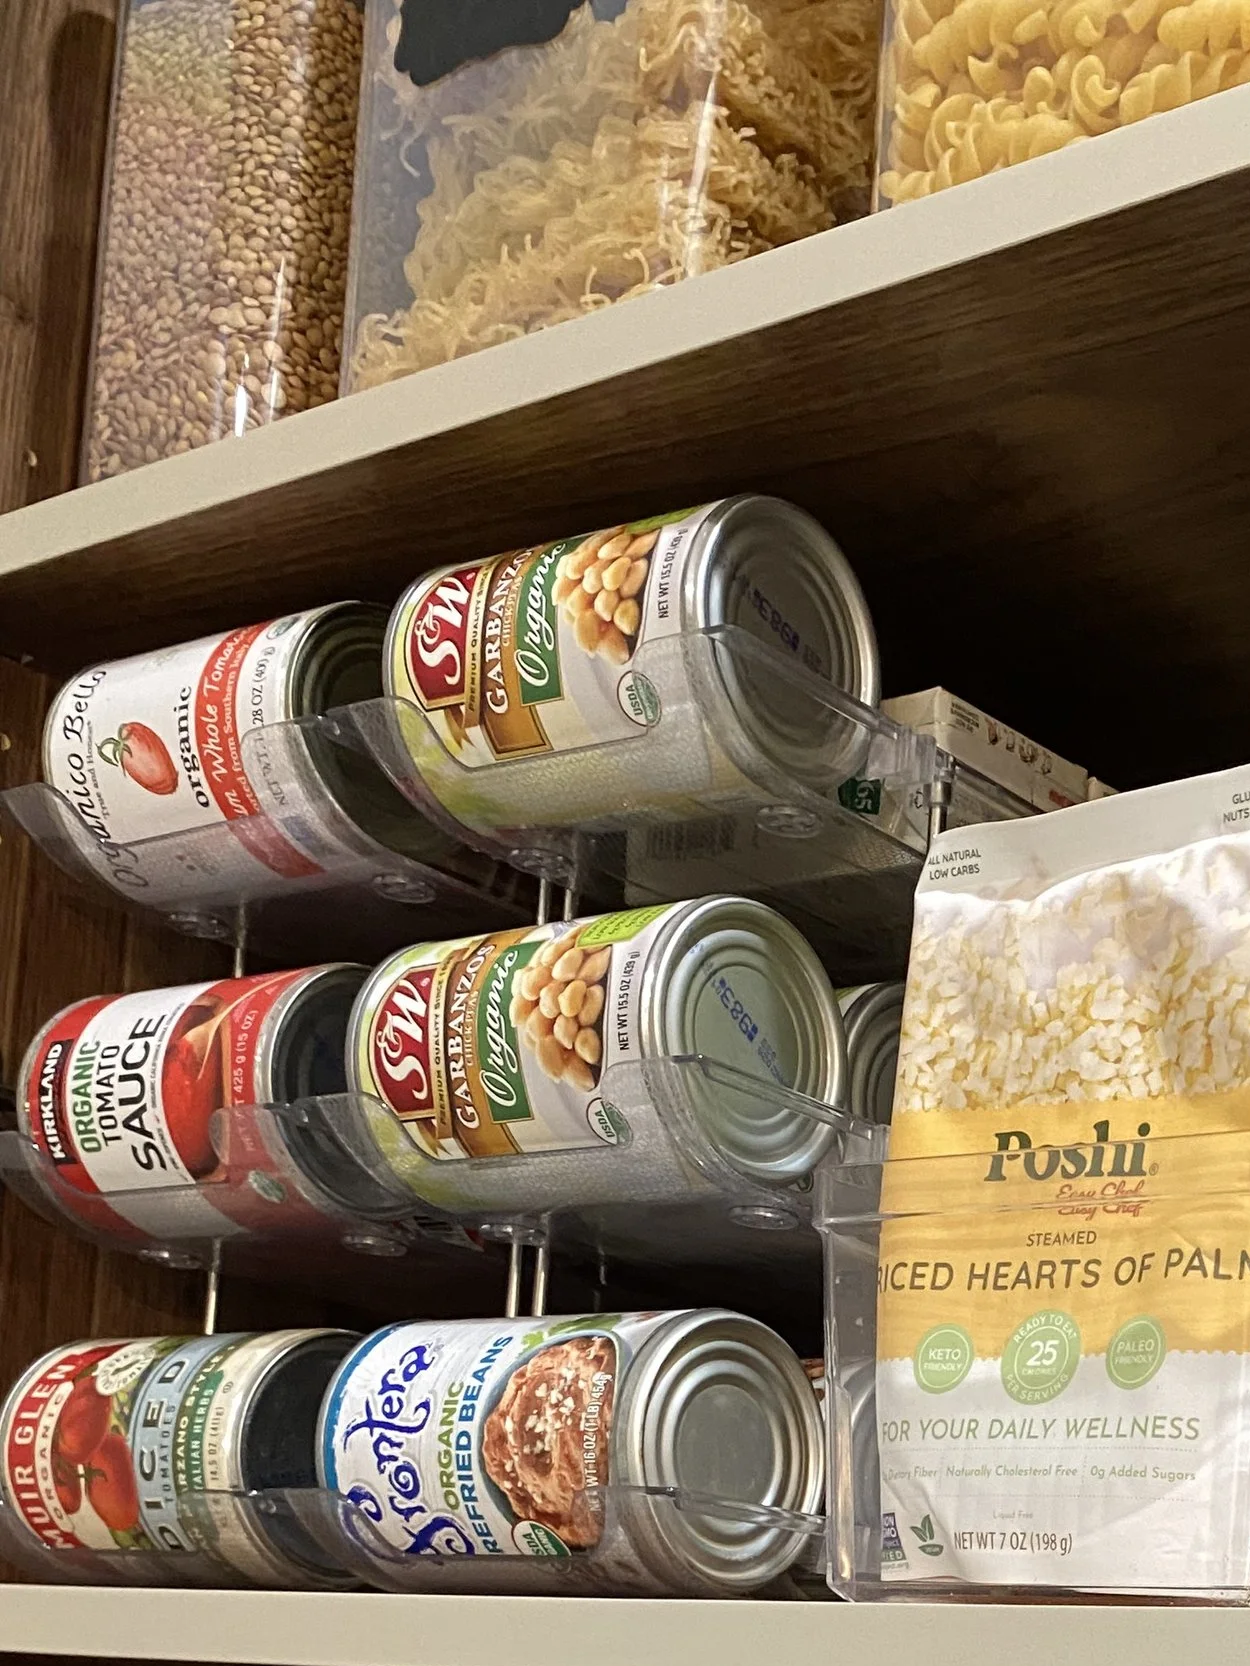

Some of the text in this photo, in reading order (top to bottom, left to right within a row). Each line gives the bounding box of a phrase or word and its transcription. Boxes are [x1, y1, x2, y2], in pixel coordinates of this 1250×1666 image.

[514, 543, 566, 688] Organic
[658, 582, 670, 619] NET WT
[485, 548, 535, 715] GARBANZO
[468, 598, 482, 712] PREMIUM QUALITY
[625, 684, 645, 716] USDA
[174, 686, 210, 808] organic
[200, 704, 228, 783] Whole
[1223, 808, 1250, 823] NUTS
[929, 864, 980, 880] LOW CARBS
[942, 849, 981, 864] NATURAL
[479, 950, 519, 1108] Organic
[618, 976, 631, 1051] NET WT OZ
[433, 1013, 442, 1065] QUALITY
[448, 944, 497, 1129] GARBANZOS
[39, 1044, 65, 1159] KIRKLAND
[71, 1041, 102, 1154] ORGANIC
[95, 1044, 122, 1146] TOMATO
[121, 1014, 168, 1172] SAUCE
[233, 1068, 244, 1094] 425
[595, 1109, 615, 1139] USDA
[984, 1120, 1151, 1182] Poshi
[1026, 1230, 1097, 1247] STEAMED
[967, 1258, 1101, 1292] HEARTS
[1113, 1252, 1156, 1287] OF
[1013, 1314, 1080, 1344] READY TO EAT
[1116, 1339, 1155, 1354] PALEO
[928, 1348, 962, 1361] KETO
[1026, 1340, 1058, 1367] 25
[1019, 1373, 1071, 1401] SERVING
[193, 1388, 214, 1433] HERBS
[882, 1415, 1200, 1442] FOR YOUR DAILY WELLNESS
[15, 1364, 74, 1549] MUIR GLEN
[37, 1391, 65, 1521] ORGANIC
[140, 1361, 190, 1549] DICED
[161, 1404, 176, 1503] TOMATOES
[437, 1381, 466, 1512] ORGANIC
[455, 1335, 515, 1554] REFRIED BEANS
[582, 1434, 596, 1449] OZ
[583, 1453, 596, 1465] 16
[584, 1469, 599, 1487] WT
[946, 1464, 1078, 1480] Naturally Cholesterol Free
[1109, 1465, 1196, 1481] Added Sugars
[954, 1531, 1073, 1555] NET WT 7 OZ (198 g)
